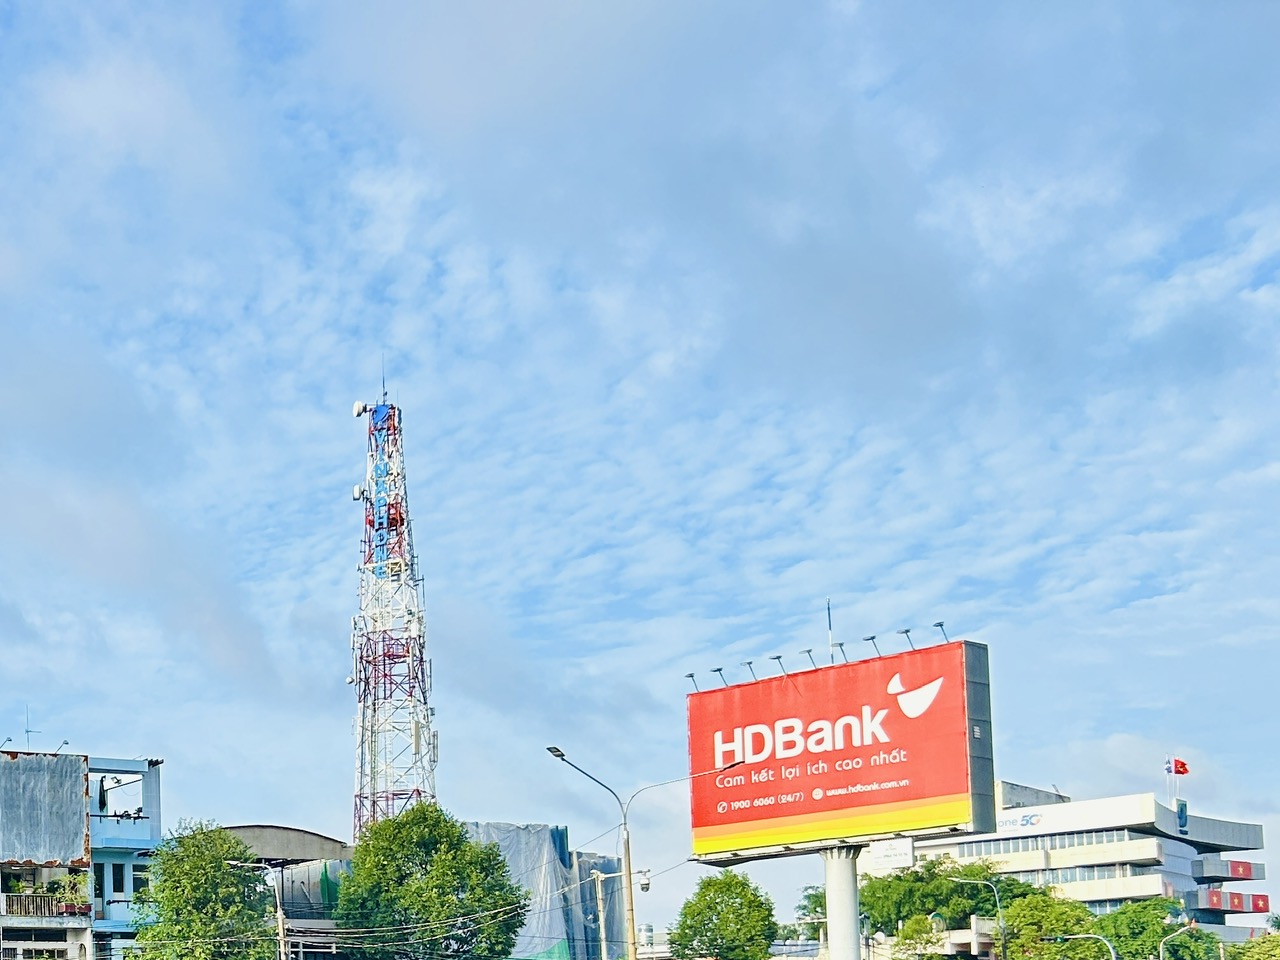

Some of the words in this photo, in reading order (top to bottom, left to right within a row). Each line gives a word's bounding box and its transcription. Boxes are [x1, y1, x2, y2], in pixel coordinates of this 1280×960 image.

[714, 705, 891, 769] HDBank
[715, 775, 745, 788] Cam
[751, 768, 775, 784] kết
[781, 764, 800, 780] lợi
[806, 760, 828, 776] ích
[835, 757, 863, 771] cao
[870, 748, 908, 766] nhất
[730, 800, 751, 811] 1900
[753, 796, 775, 807] 6060
[777, 791, 804, 805] (24/7)
[826, 779, 910, 797] www.hdbank.com.vn
